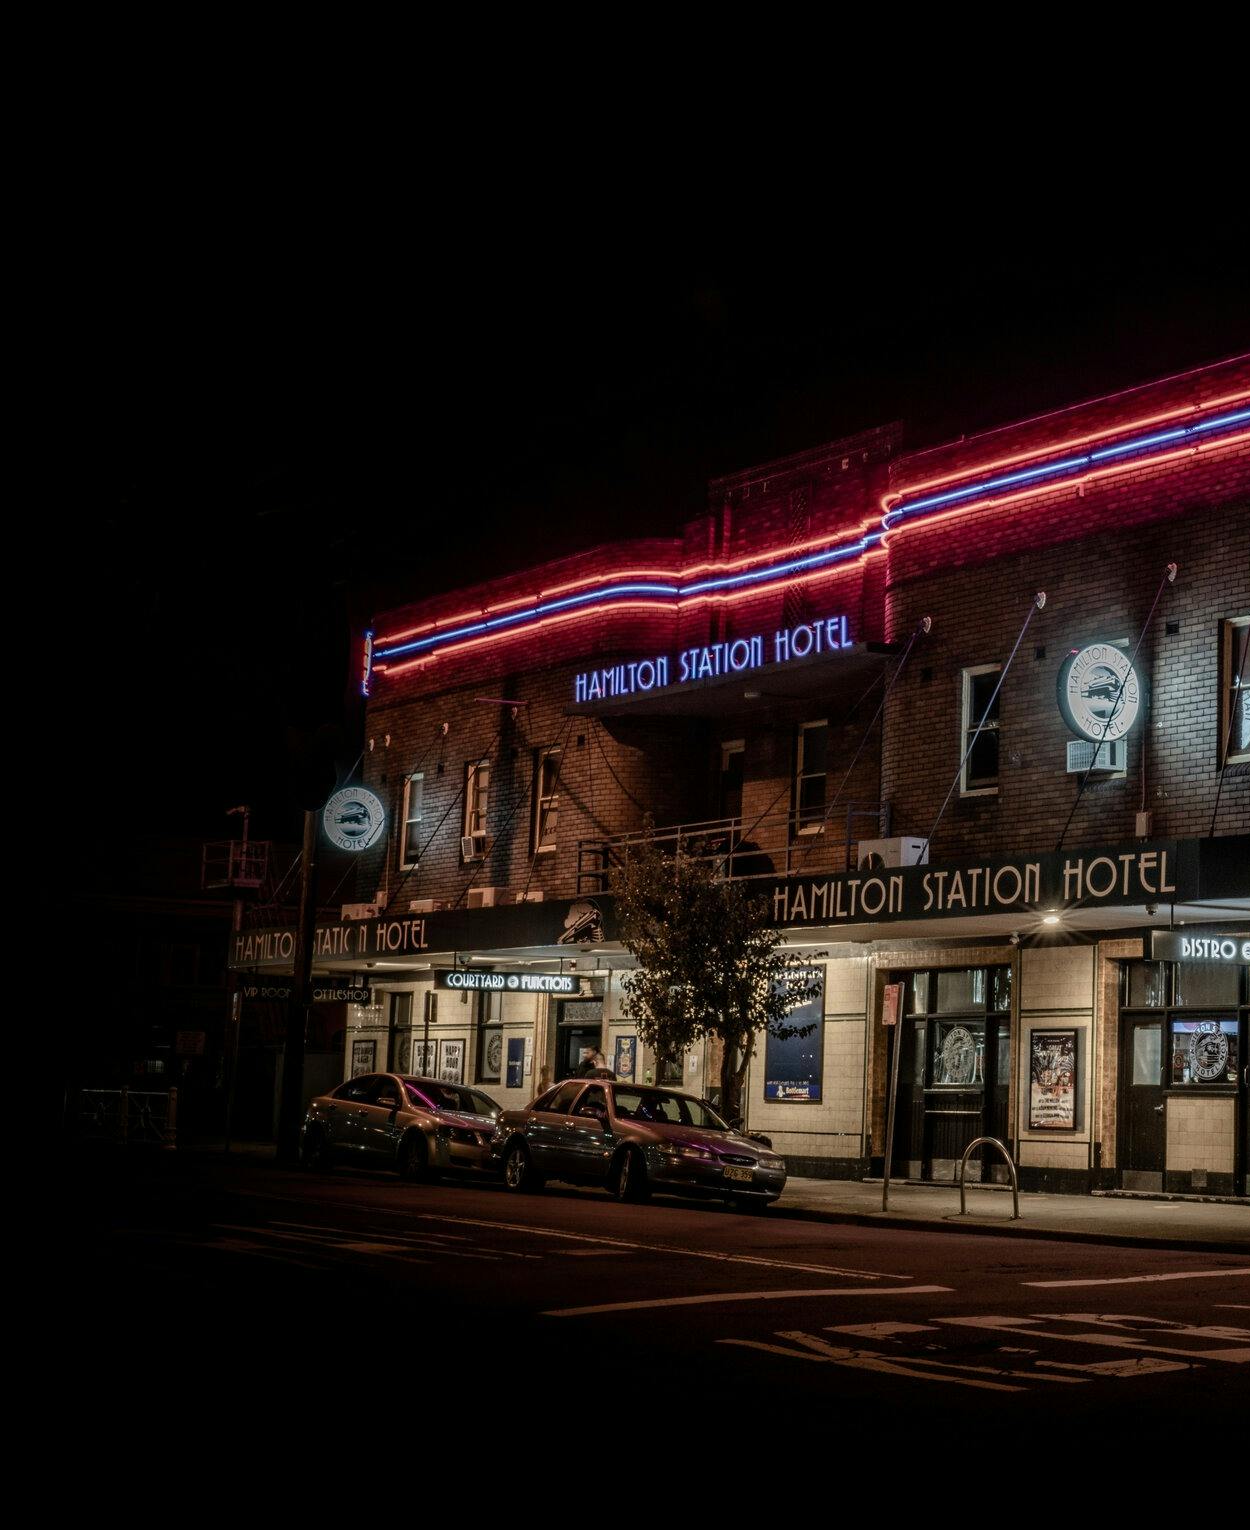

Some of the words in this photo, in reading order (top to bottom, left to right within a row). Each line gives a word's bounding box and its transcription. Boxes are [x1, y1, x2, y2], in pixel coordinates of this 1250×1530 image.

[574, 656, 668, 703] HAMILTON
[680, 635, 764, 683] STATION
[774, 615, 853, 663] HOTEL
[1070, 647, 1107, 694] HAMILTON
[1114, 653, 1138, 704] STATION
[1085, 717, 1124, 737] HOTEL
[338, 836, 368, 849] HOTEL
[773, 876, 903, 922] HAMILTON
[923, 862, 1040, 912] STATION
[1063, 851, 1176, 901] HOTEL
[235, 931, 297, 961] HAMILTO
[312, 924, 367, 955] TATIN
[376, 919, 428, 950] HOTEL
[1181, 938, 1236, 960] BISTRO
[447, 973, 505, 988] COURTYARD
[521, 975, 572, 991] FUNCTIONS
[244, 986, 259, 998] VIP
[312, 989, 369, 1001] OTTLESHOP
